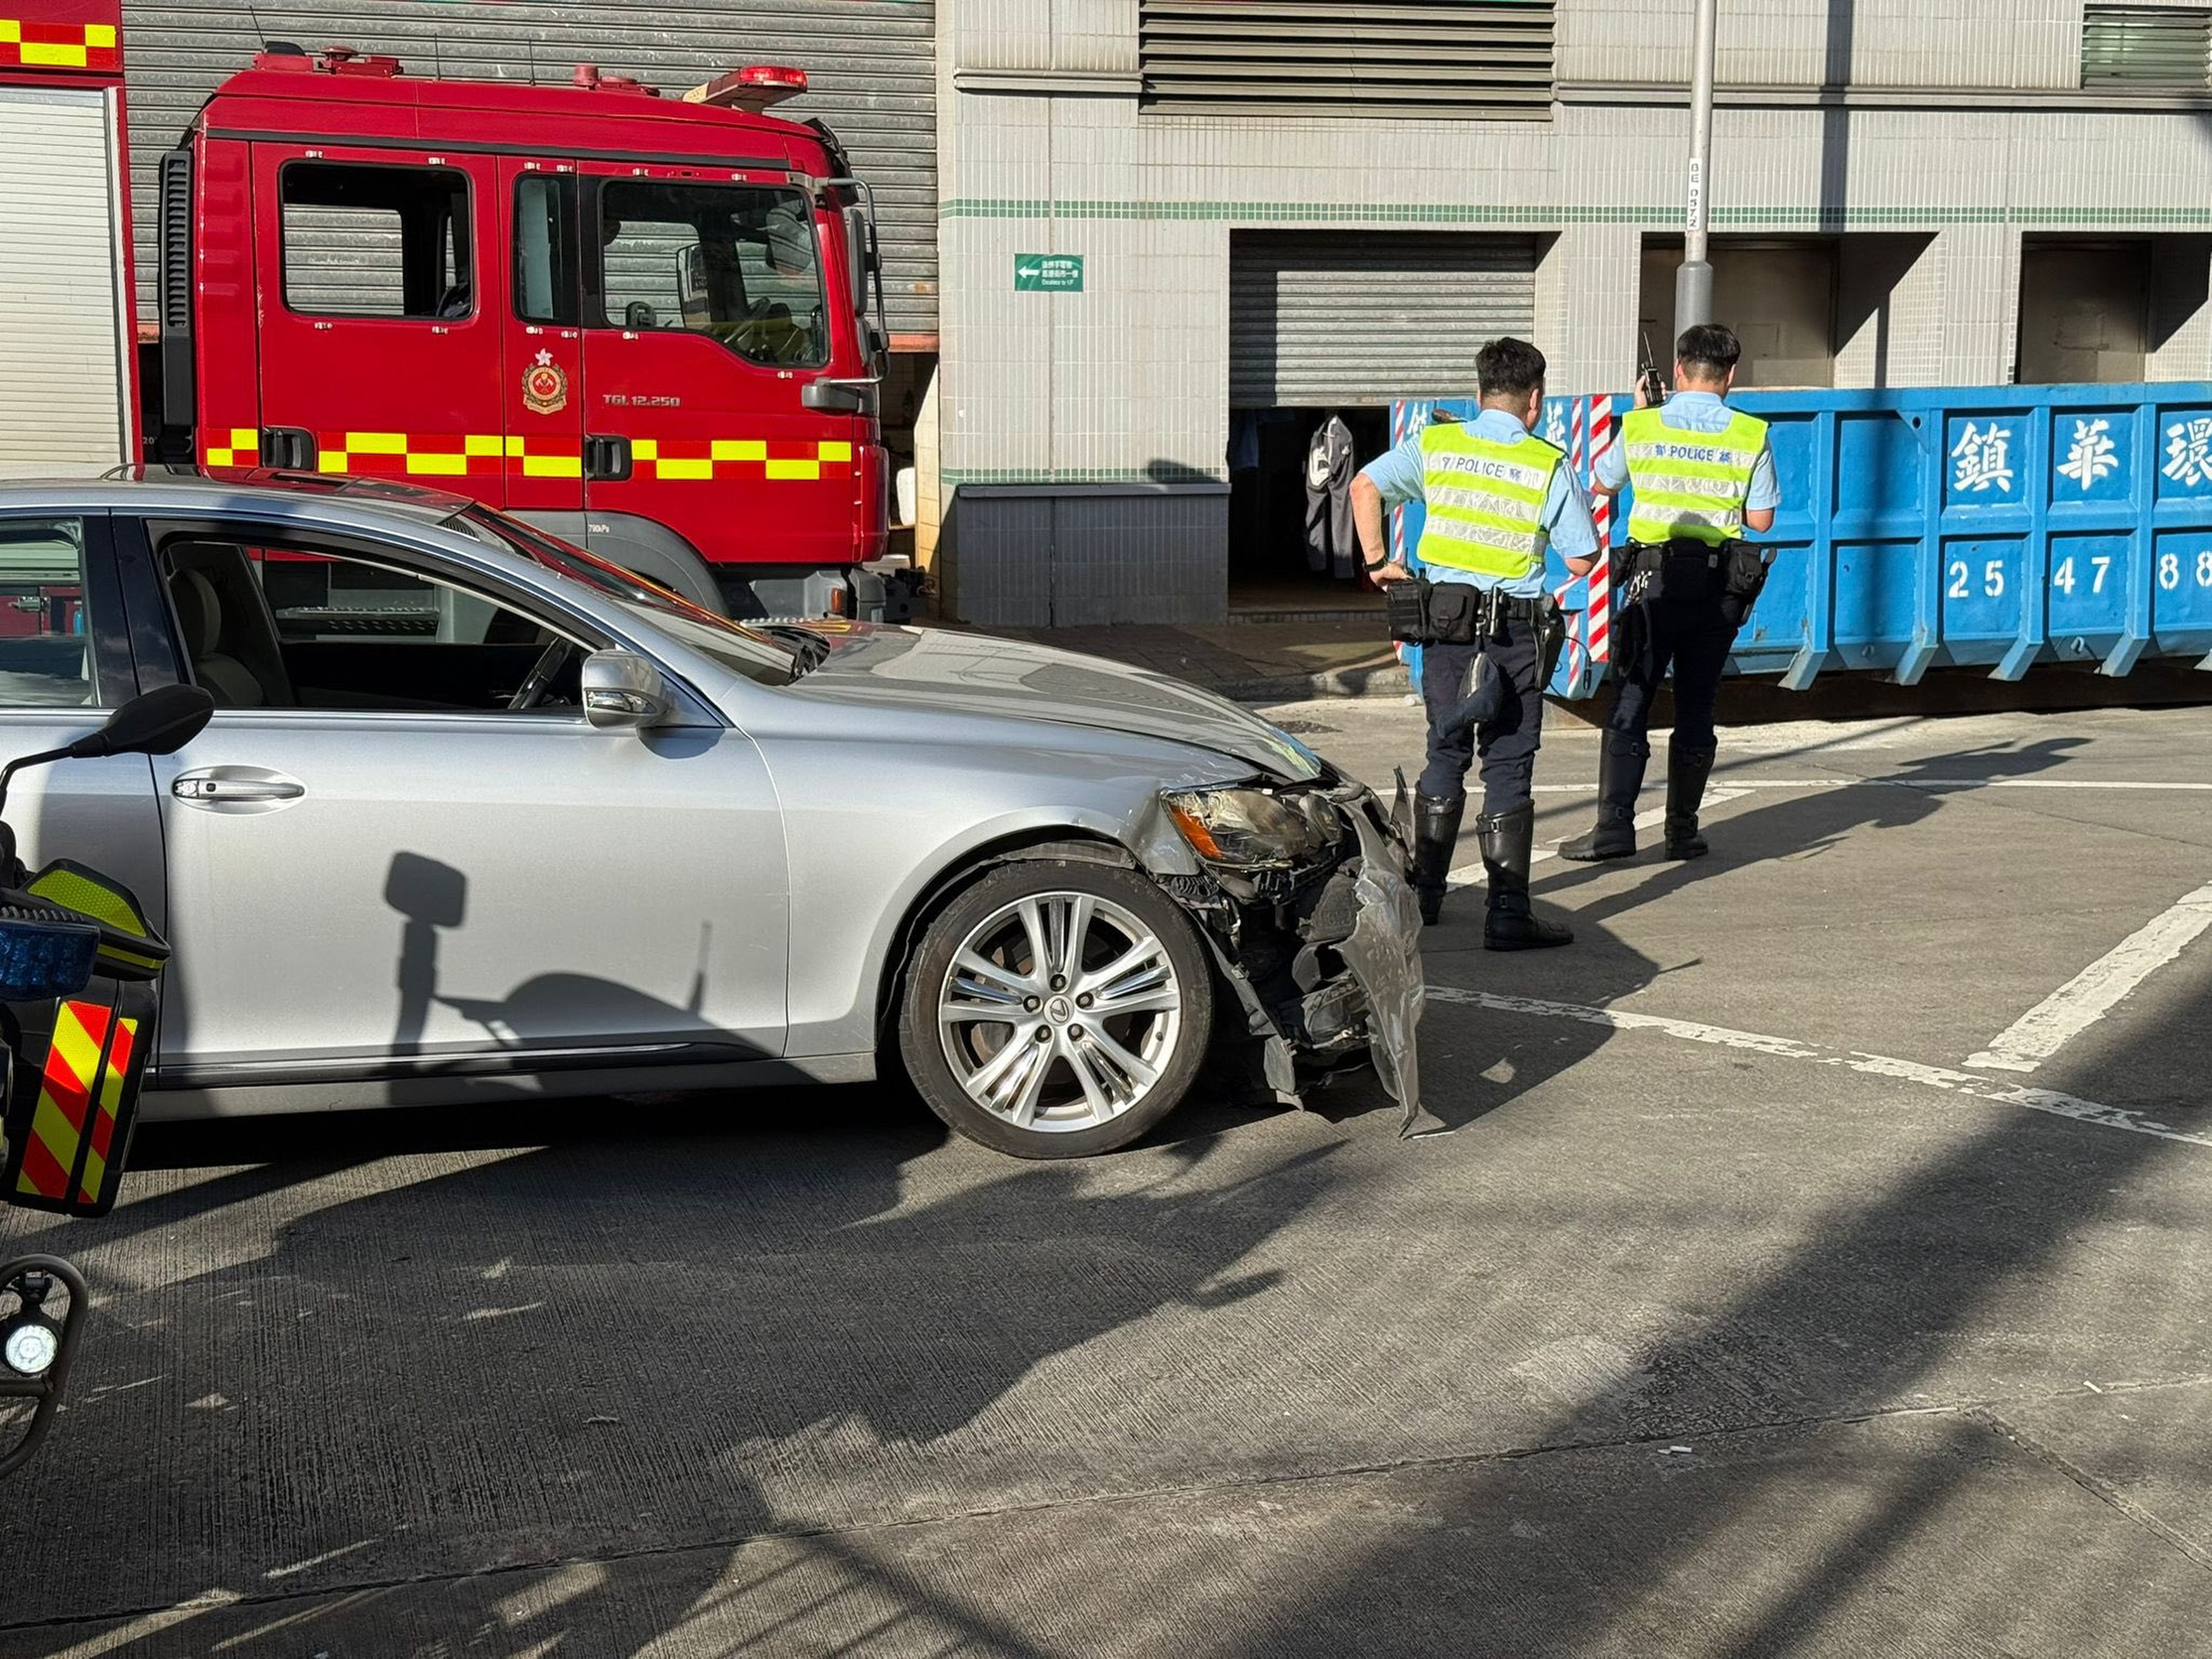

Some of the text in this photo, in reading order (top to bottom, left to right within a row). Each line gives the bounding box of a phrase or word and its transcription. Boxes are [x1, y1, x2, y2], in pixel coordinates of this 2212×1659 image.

[1691, 163, 1699, 183] BE
[631, 395, 680, 406] 12.250
[1670, 446, 1714, 461] POLICE
[1456, 457, 1504, 478] POLICE
